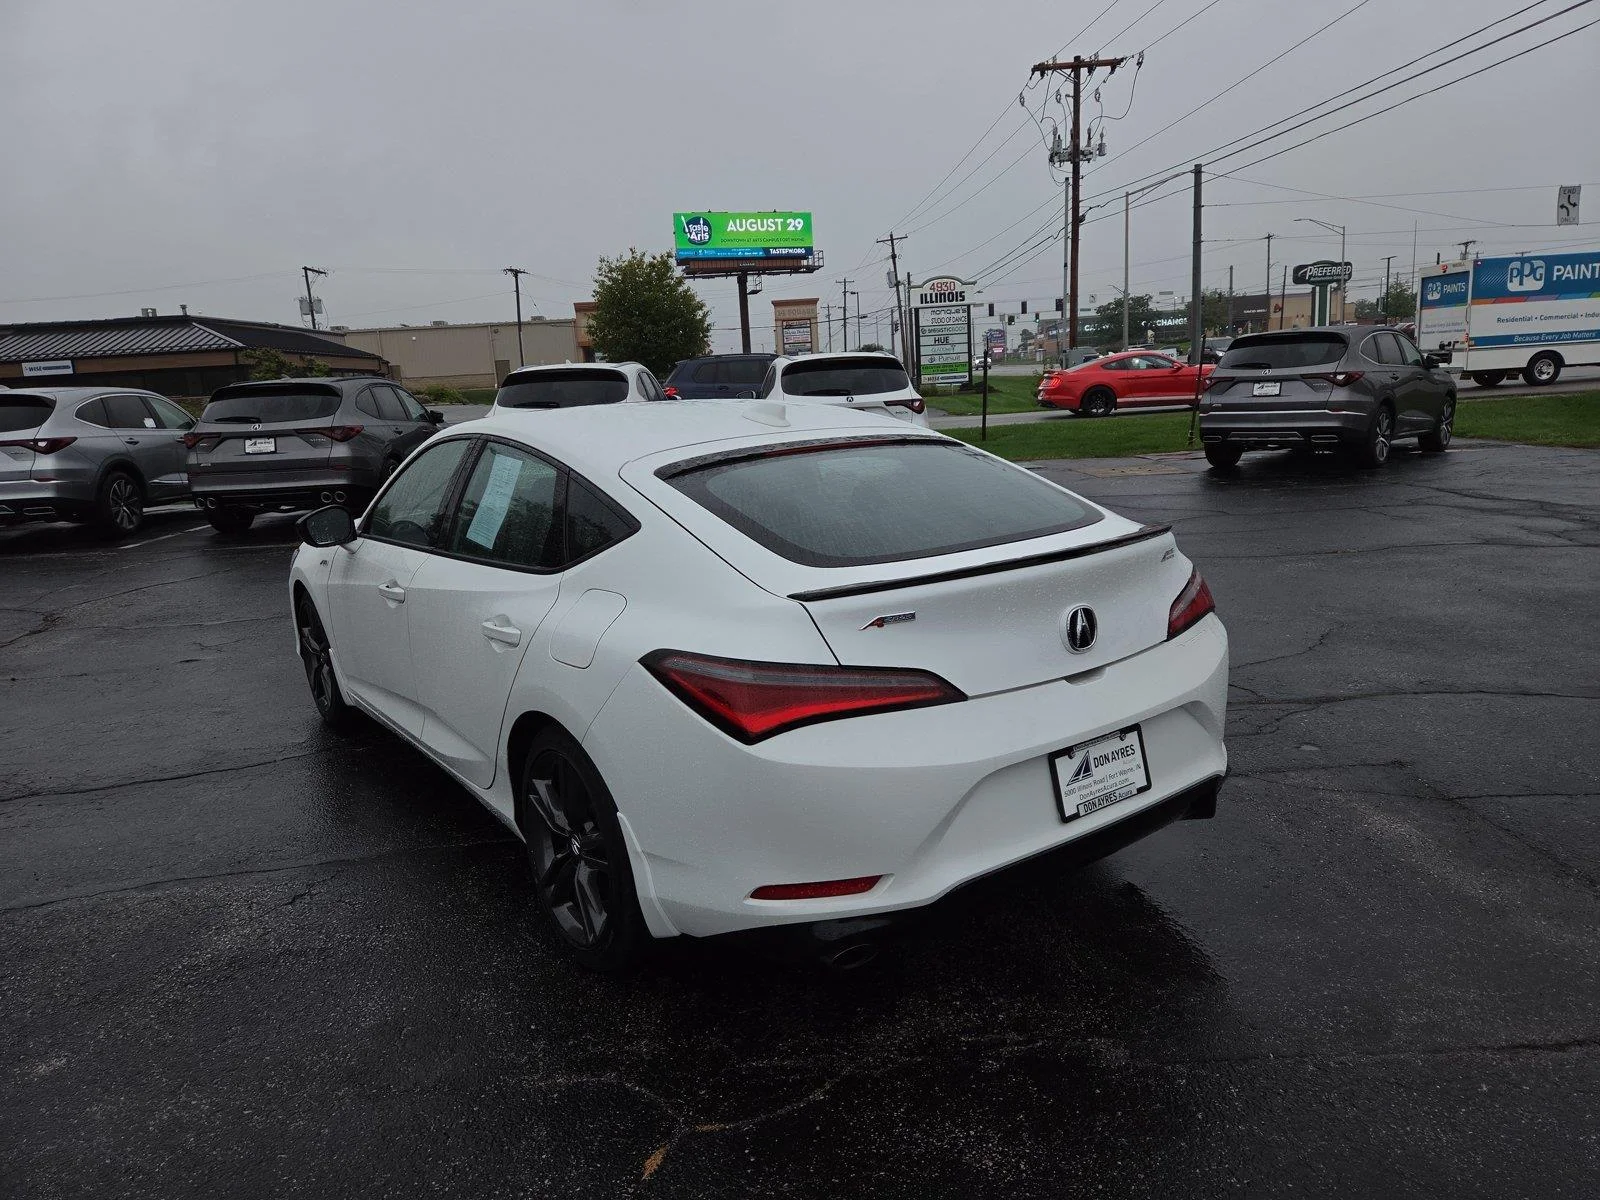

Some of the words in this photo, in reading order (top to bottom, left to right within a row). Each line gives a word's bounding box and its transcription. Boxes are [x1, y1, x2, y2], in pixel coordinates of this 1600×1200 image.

[688, 223, 709, 233] Taste
[727, 218, 784, 232] AUGUST
[786, 218, 804, 231] 29
[1306, 265, 1352, 279] PREFERRED
[1508, 260, 1545, 288] PPG
[929, 281, 956, 292] 4930
[1443, 282, 1466, 294] PAINTS
[920, 290, 966, 304] ILLINOIS
[1496, 314, 1534, 323] Residential
[1539, 312, 1579, 321] Commercial
[933, 336, 950, 344] HUE
[1513, 335, 1540, 343] Because
[1541, 333, 1559, 341] Every
[1093, 752, 1111, 768] DON
[1111, 744, 1136, 762] AYRES
[1064, 787, 1077, 798] 5000
[1093, 777, 1105, 786] Road
[1108, 772, 1119, 780] Fort
[1118, 766, 1136, 776] Wayne,
[1083, 799, 1098, 813] DON
[1097, 791, 1118, 808] AYRES
[1118, 789, 1133, 799] Acura
